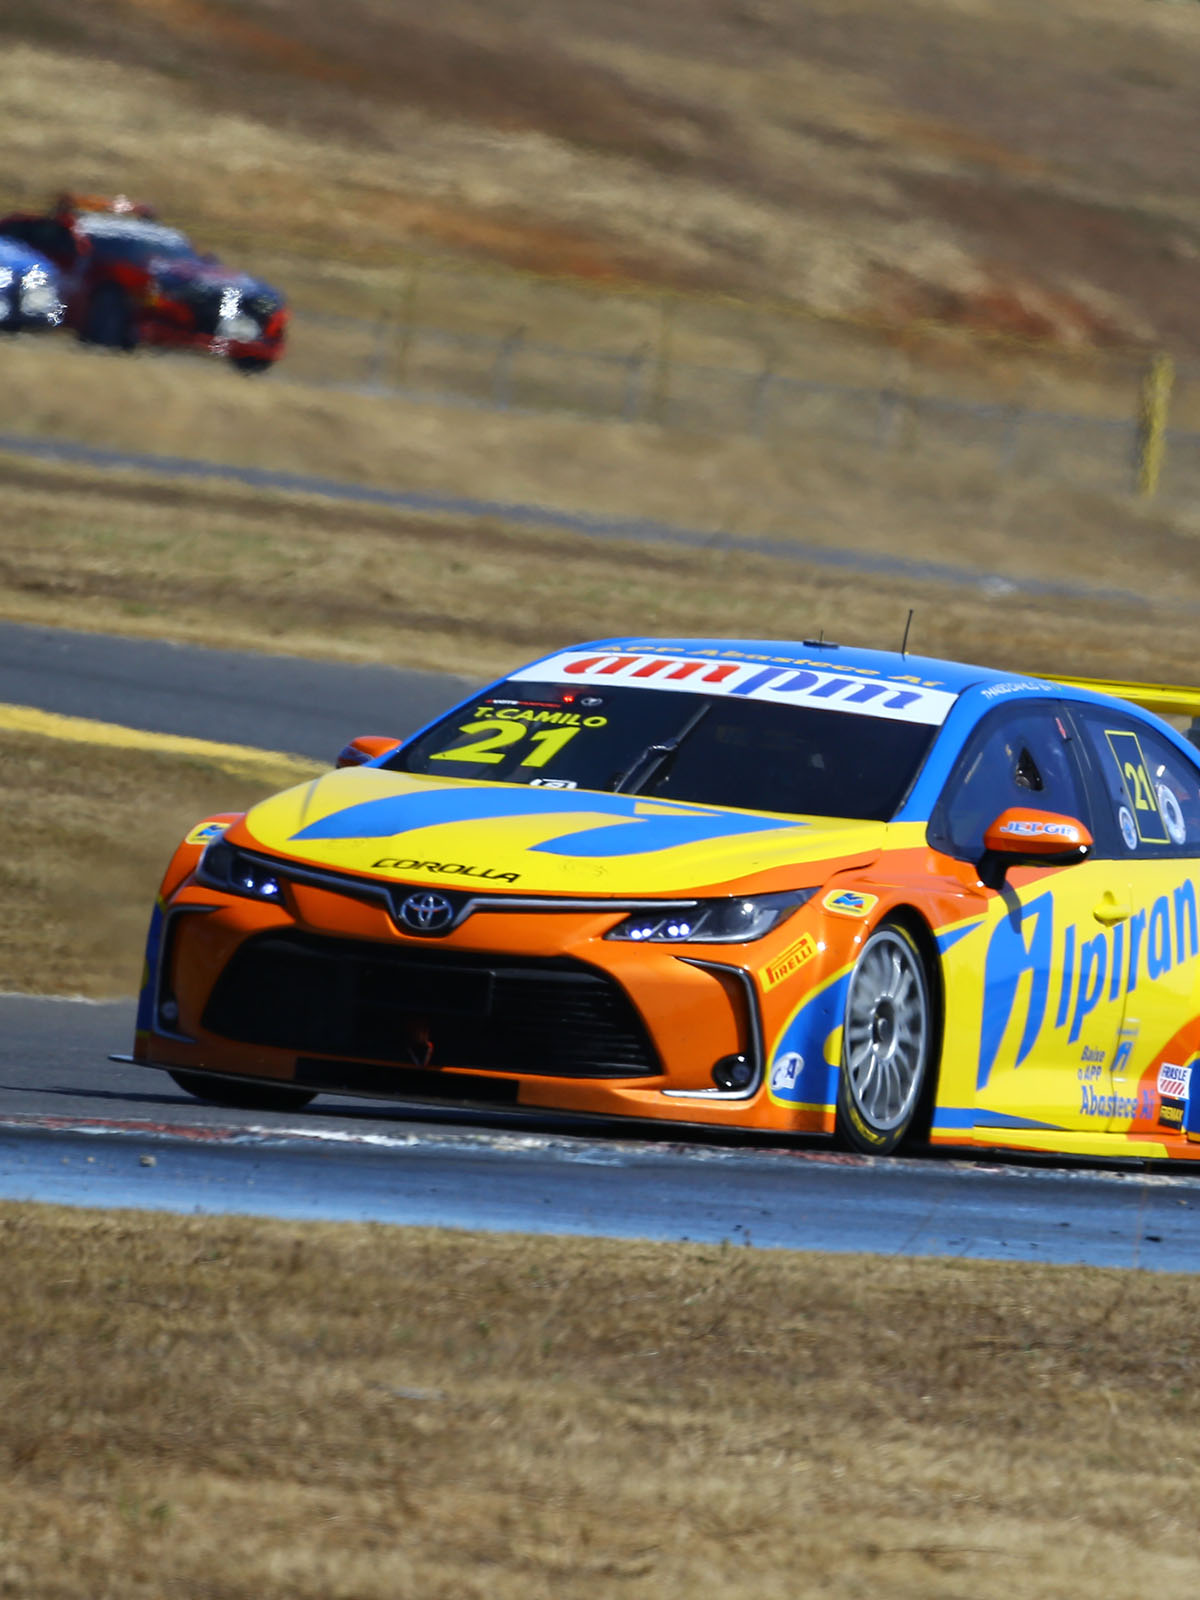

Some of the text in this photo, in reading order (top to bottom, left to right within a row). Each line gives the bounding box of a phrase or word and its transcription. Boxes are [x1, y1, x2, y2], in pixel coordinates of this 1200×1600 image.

[474, 706, 608, 727] T.CAMILO
[429, 719, 581, 767] 21
[1124, 761, 1158, 811] 21
[371, 858, 521, 883] COROLLA
[766, 938, 813, 984] PIRELLI
[1085, 1066, 1102, 1082] APP
[1080, 1085, 1138, 1118] Abastece
